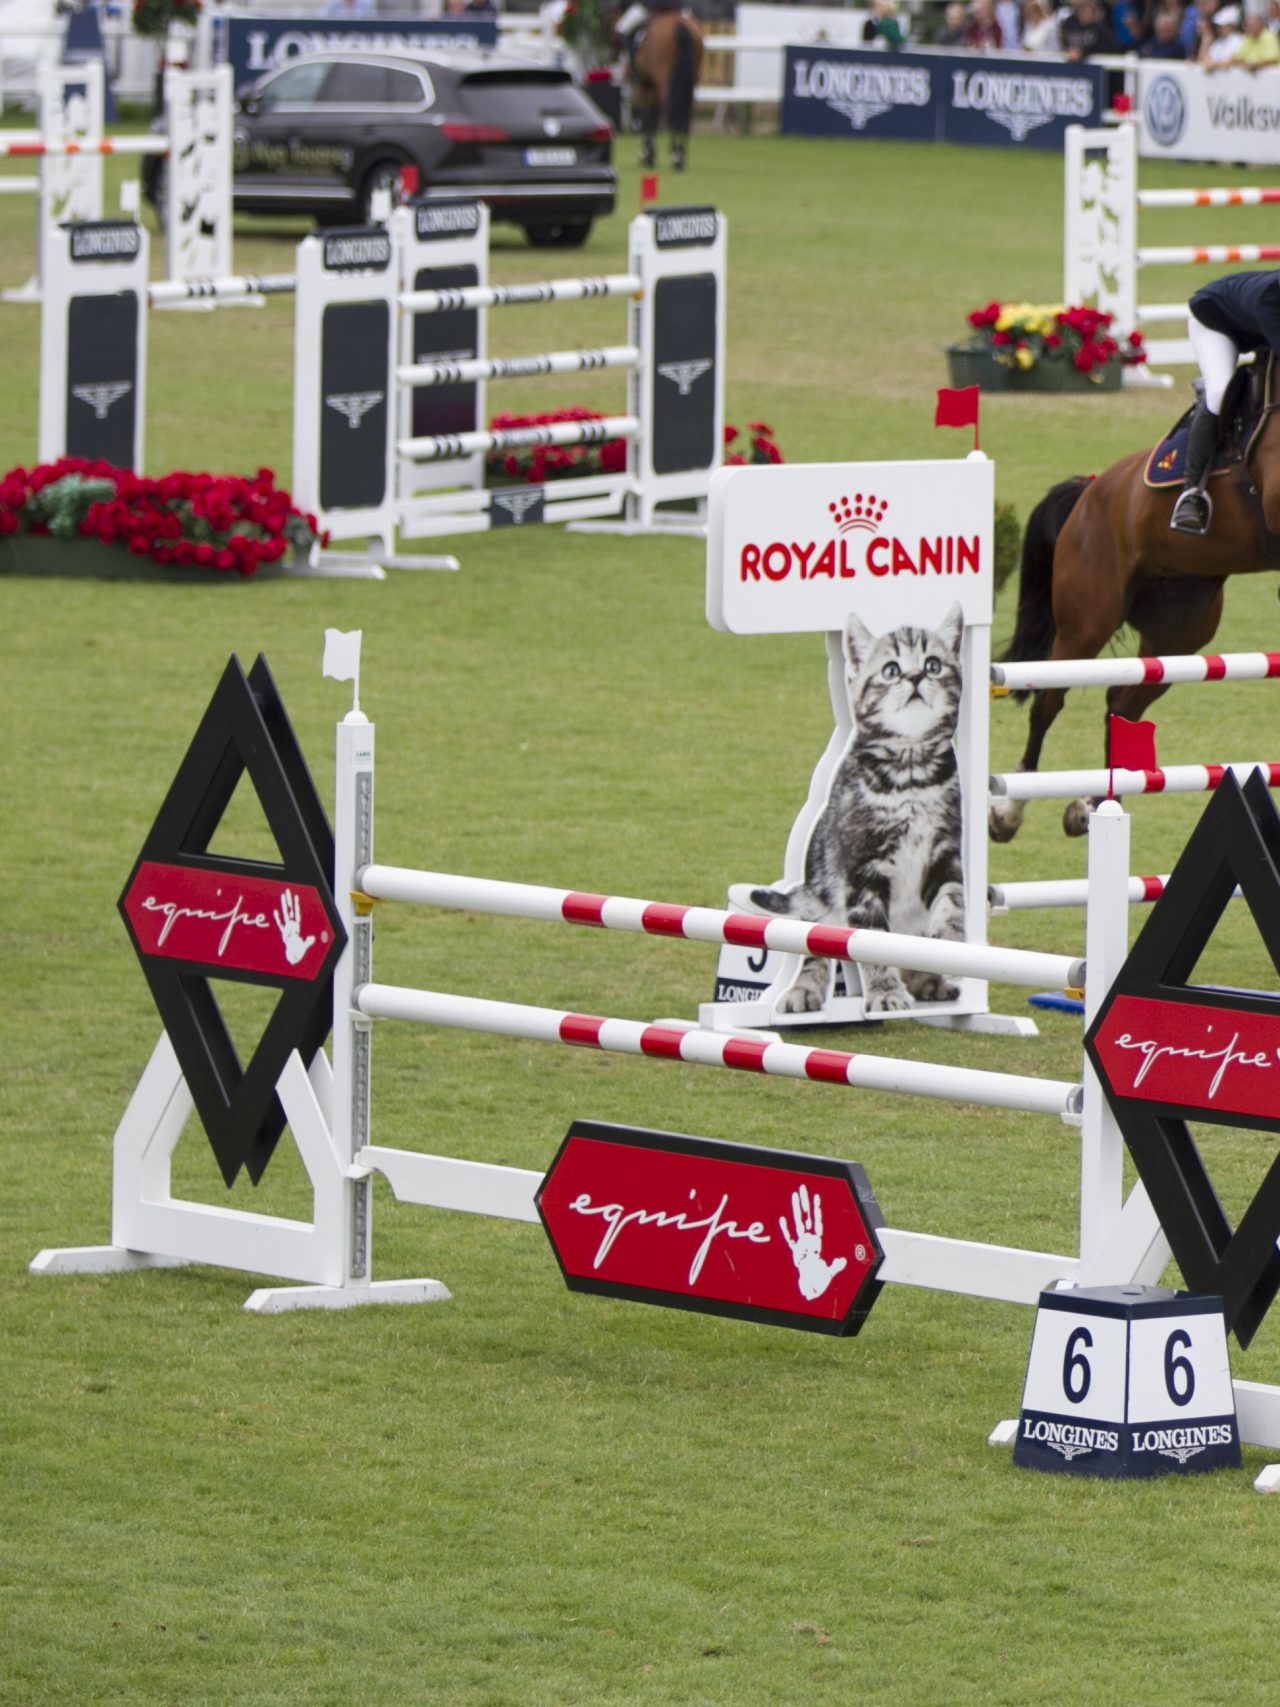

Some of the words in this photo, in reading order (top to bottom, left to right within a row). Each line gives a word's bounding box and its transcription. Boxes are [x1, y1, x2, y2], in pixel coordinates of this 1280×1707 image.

[793, 60, 931, 107] LONGINES
[951, 70, 1094, 118] LONGINES
[72, 228, 138, 257] LONGINES
[417, 205, 477, 234] LONGINES
[657, 213, 715, 241] LONGINES
[326, 238, 390, 266] LONGINES
[740, 539, 856, 582] ROYAL
[866, 534, 980, 577] CANIN
[141, 888, 271, 957] equipe
[1114, 1025, 1272, 1099] equipe
[569, 1188, 771, 1286] equipe
[1062, 1326, 1093, 1404] 6
[1164, 1329, 1195, 1406] 6
[1023, 1419, 1119, 1452] LONGINES
[1132, 1425, 1232, 1452] LONGINES
